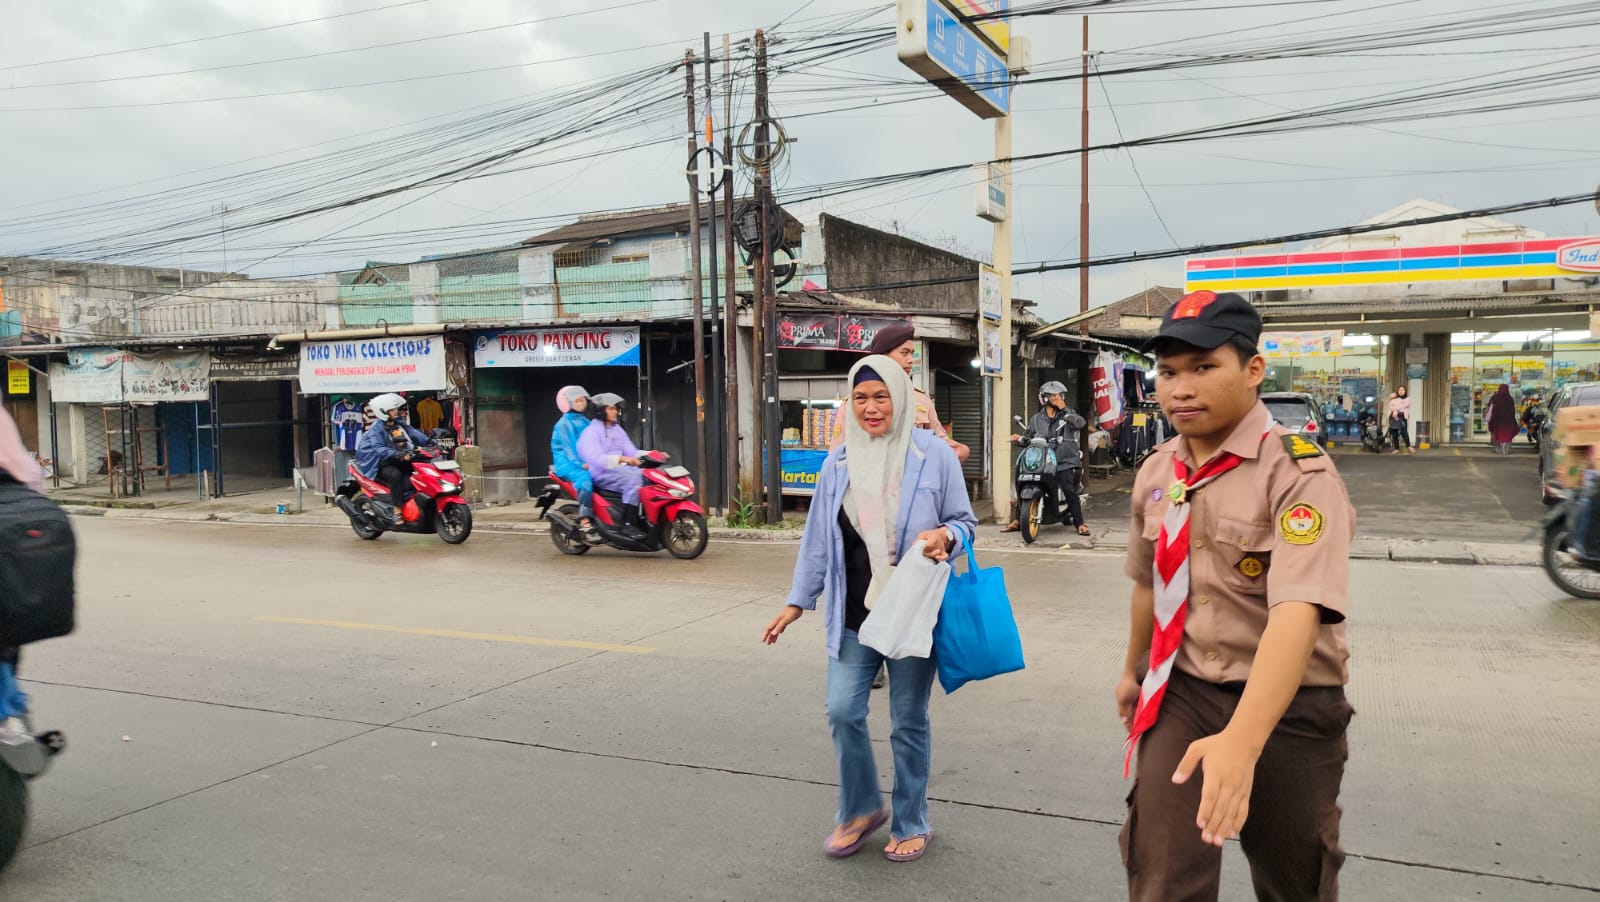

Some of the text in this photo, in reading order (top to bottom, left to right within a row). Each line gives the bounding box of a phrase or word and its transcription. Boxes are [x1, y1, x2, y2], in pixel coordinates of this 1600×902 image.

[498, 331, 611, 351] TOKO PANCING
[790, 325, 825, 337] PRIMA
[307, 343, 330, 360] TOKO
[334, 343, 357, 359] VIKI
[361, 339, 431, 358] COLECTIONS
